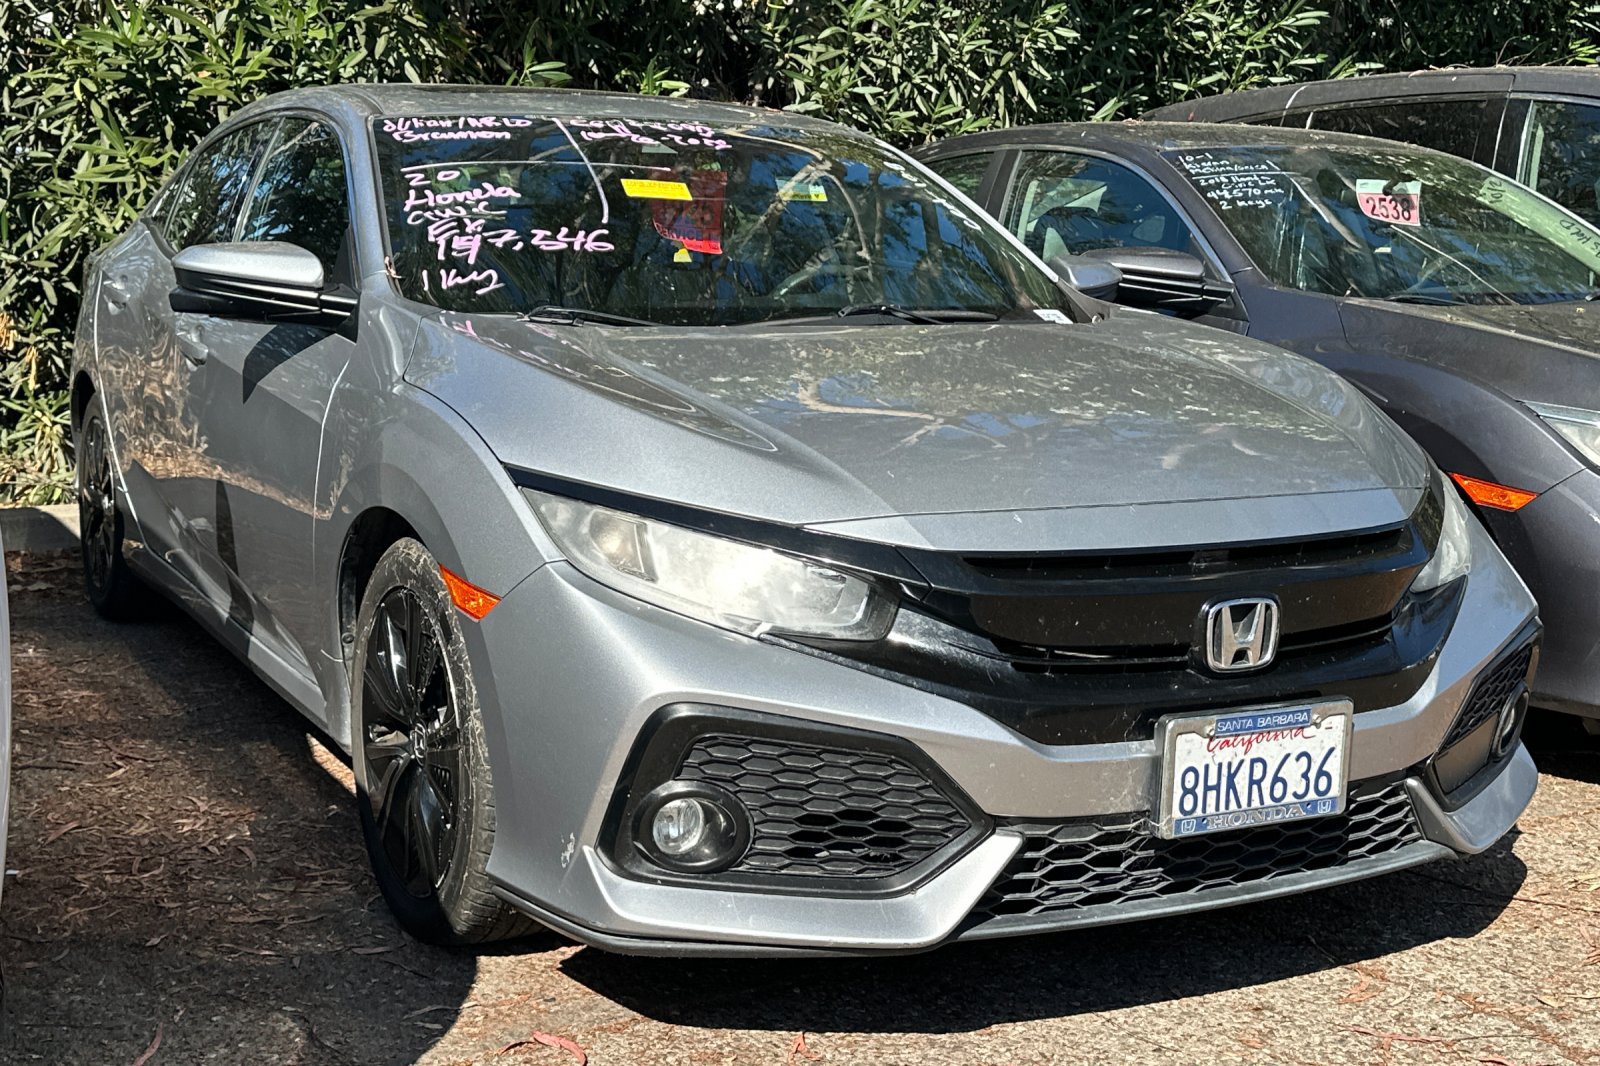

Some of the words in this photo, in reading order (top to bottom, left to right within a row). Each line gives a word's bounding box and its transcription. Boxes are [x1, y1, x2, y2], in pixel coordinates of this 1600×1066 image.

[1366, 196, 1412, 222] 2538
[1217, 718, 1255, 732] SANTA
[1257, 711, 1310, 727] BARBARA
[1206, 726, 1317, 755] California
[1178, 746, 1337, 817] 8HKR636
[1206, 804, 1308, 830] HONDA
